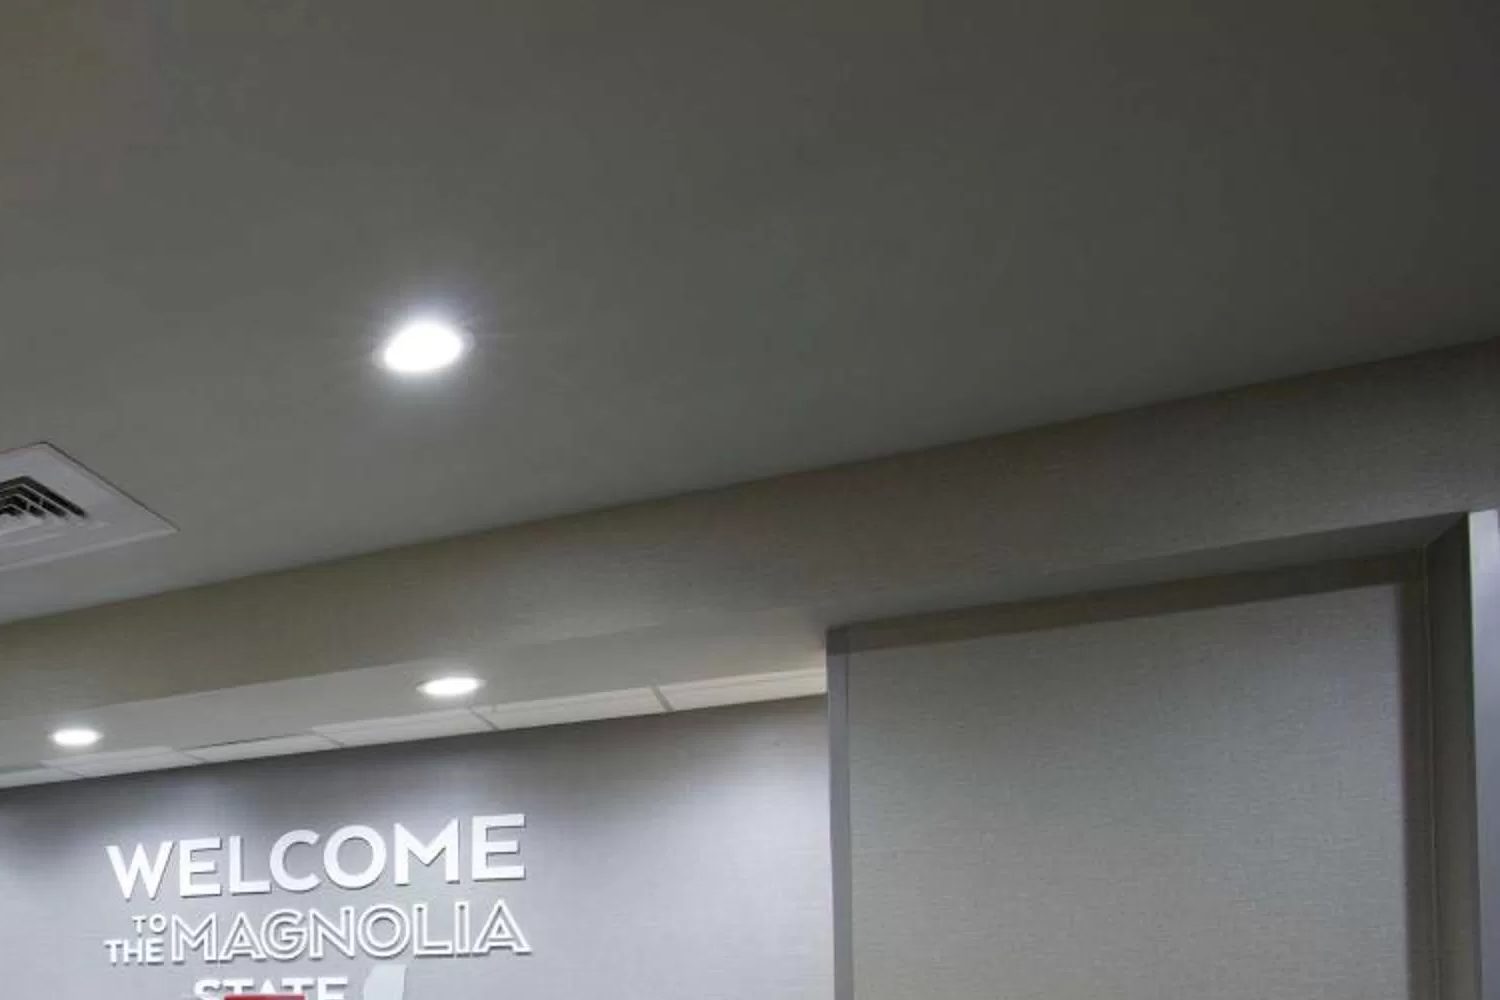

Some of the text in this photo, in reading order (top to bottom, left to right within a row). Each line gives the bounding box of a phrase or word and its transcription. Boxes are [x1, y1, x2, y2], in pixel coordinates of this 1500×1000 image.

[106, 813, 526, 899] WELCOME
[104, 898, 532, 964] THE MAGNOLIA
[132, 914, 167, 934] TO
